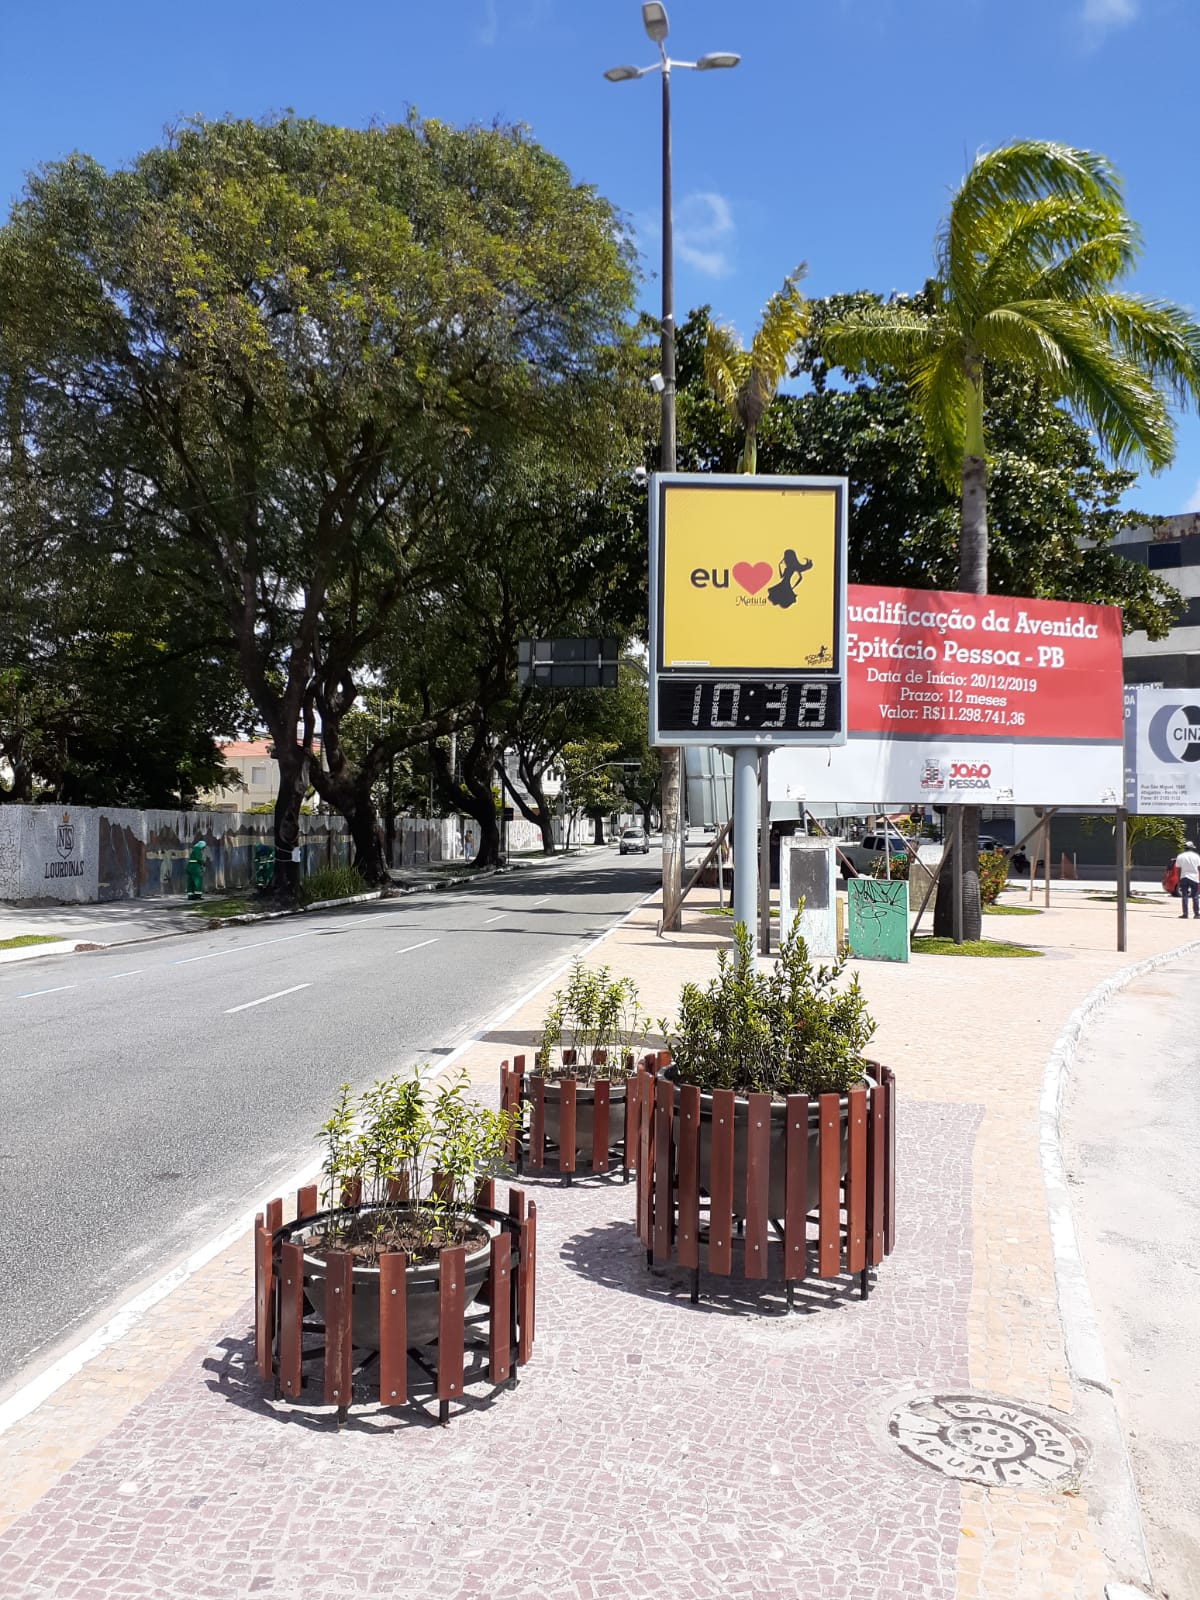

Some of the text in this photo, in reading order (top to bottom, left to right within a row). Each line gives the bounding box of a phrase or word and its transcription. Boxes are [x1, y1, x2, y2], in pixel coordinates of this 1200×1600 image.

[690, 568, 729, 588] eu
[847, 600, 1098, 639] ualificação da Avenida
[847, 633, 937, 663] Epitácio
[943, 640, 1021, 666] Pessoa
[1037, 645, 1065, 668] PB
[866, 668, 1037, 692] Data de Início: 20/12/2019
[691, 682, 829, 728] 10:38
[900, 687, 1007, 707] Prazo: 12 meses
[879, 704, 1025, 725] Valor: R$11.298.741,36
[949, 779, 991, 789] PESSOA
[44, 860, 84, 879] LOURDINAS
